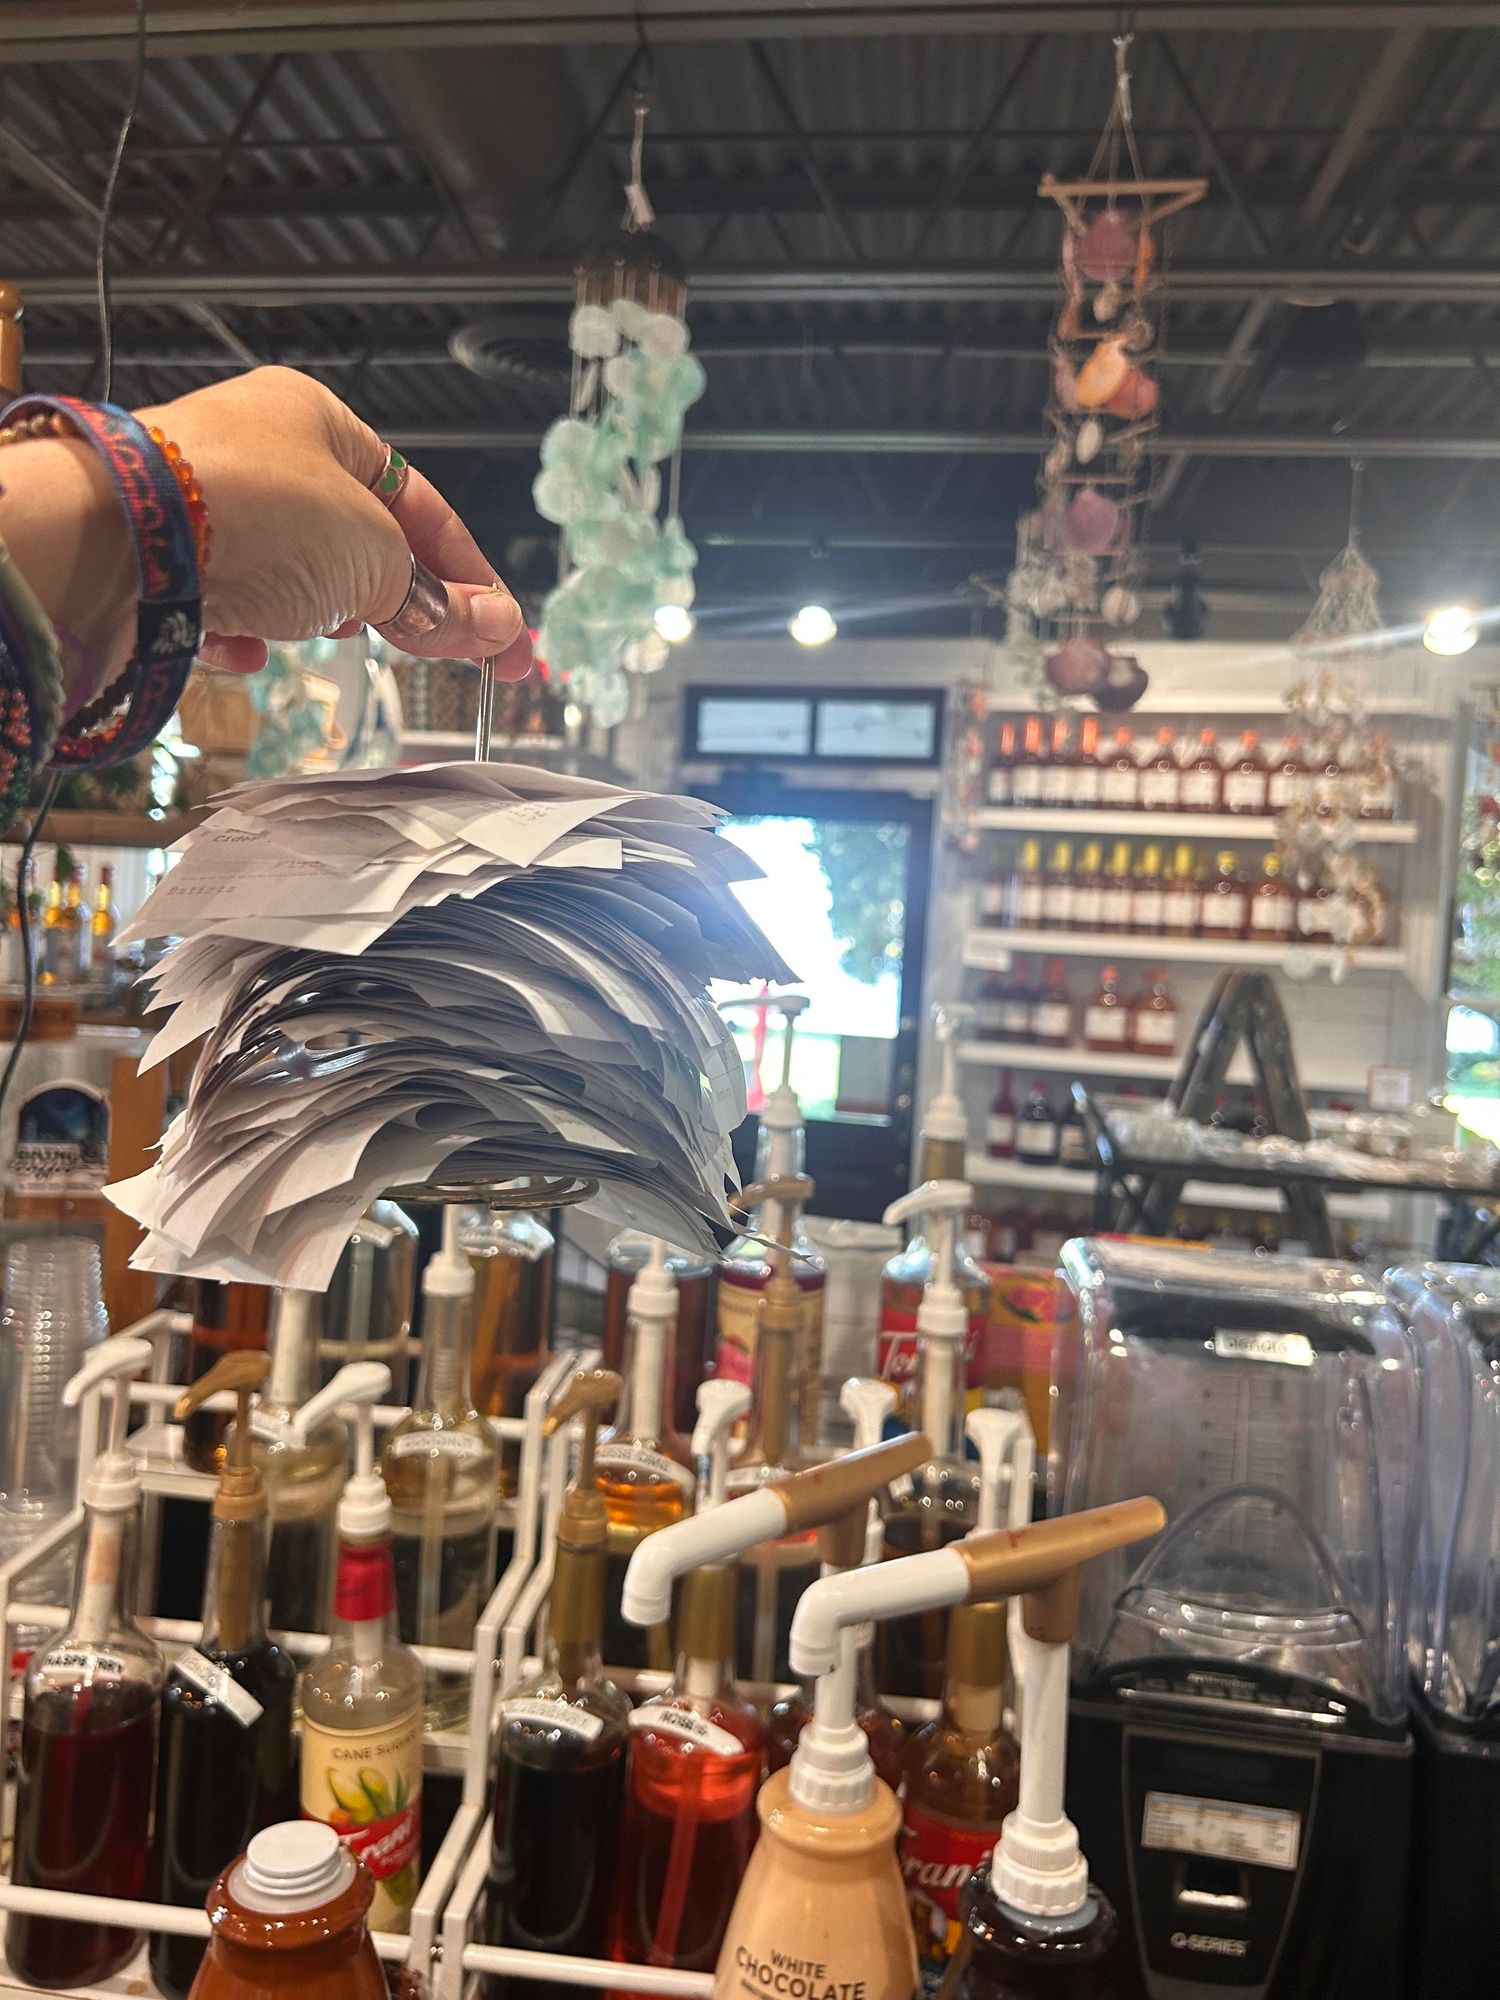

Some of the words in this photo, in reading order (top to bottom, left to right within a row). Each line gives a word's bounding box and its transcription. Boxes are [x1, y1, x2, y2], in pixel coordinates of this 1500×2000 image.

[333, 1747, 372, 1761] CANE
[735, 1945, 867, 2000] CHOCOLATE
[771, 1949, 827, 1979] WHITE
